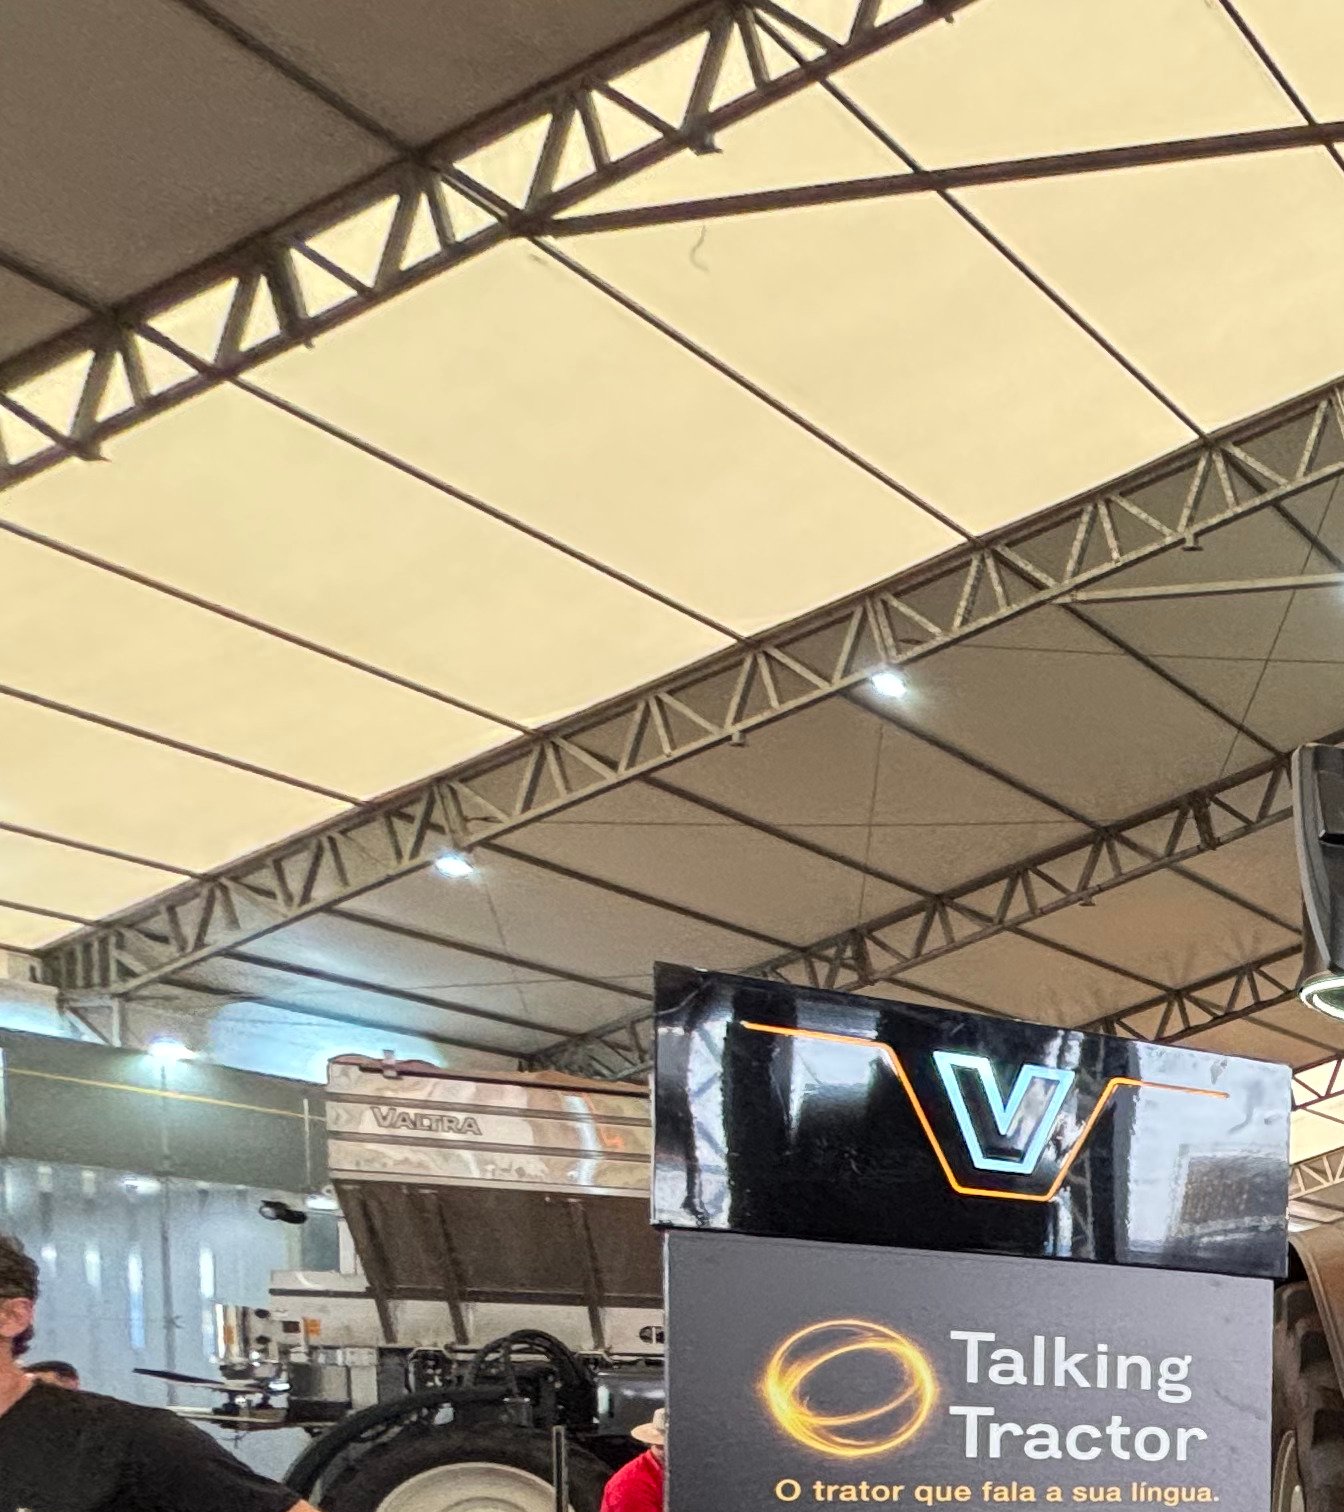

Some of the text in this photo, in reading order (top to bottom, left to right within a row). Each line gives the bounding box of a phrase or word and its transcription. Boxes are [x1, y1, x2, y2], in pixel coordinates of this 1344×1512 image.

[369, 1105, 484, 1137] VALTRA
[950, 1330, 1193, 1404] Talking
[949, 1405, 1209, 1462] Tractor
[775, 1478, 1220, 1507] O trator que fala a sua língua.
